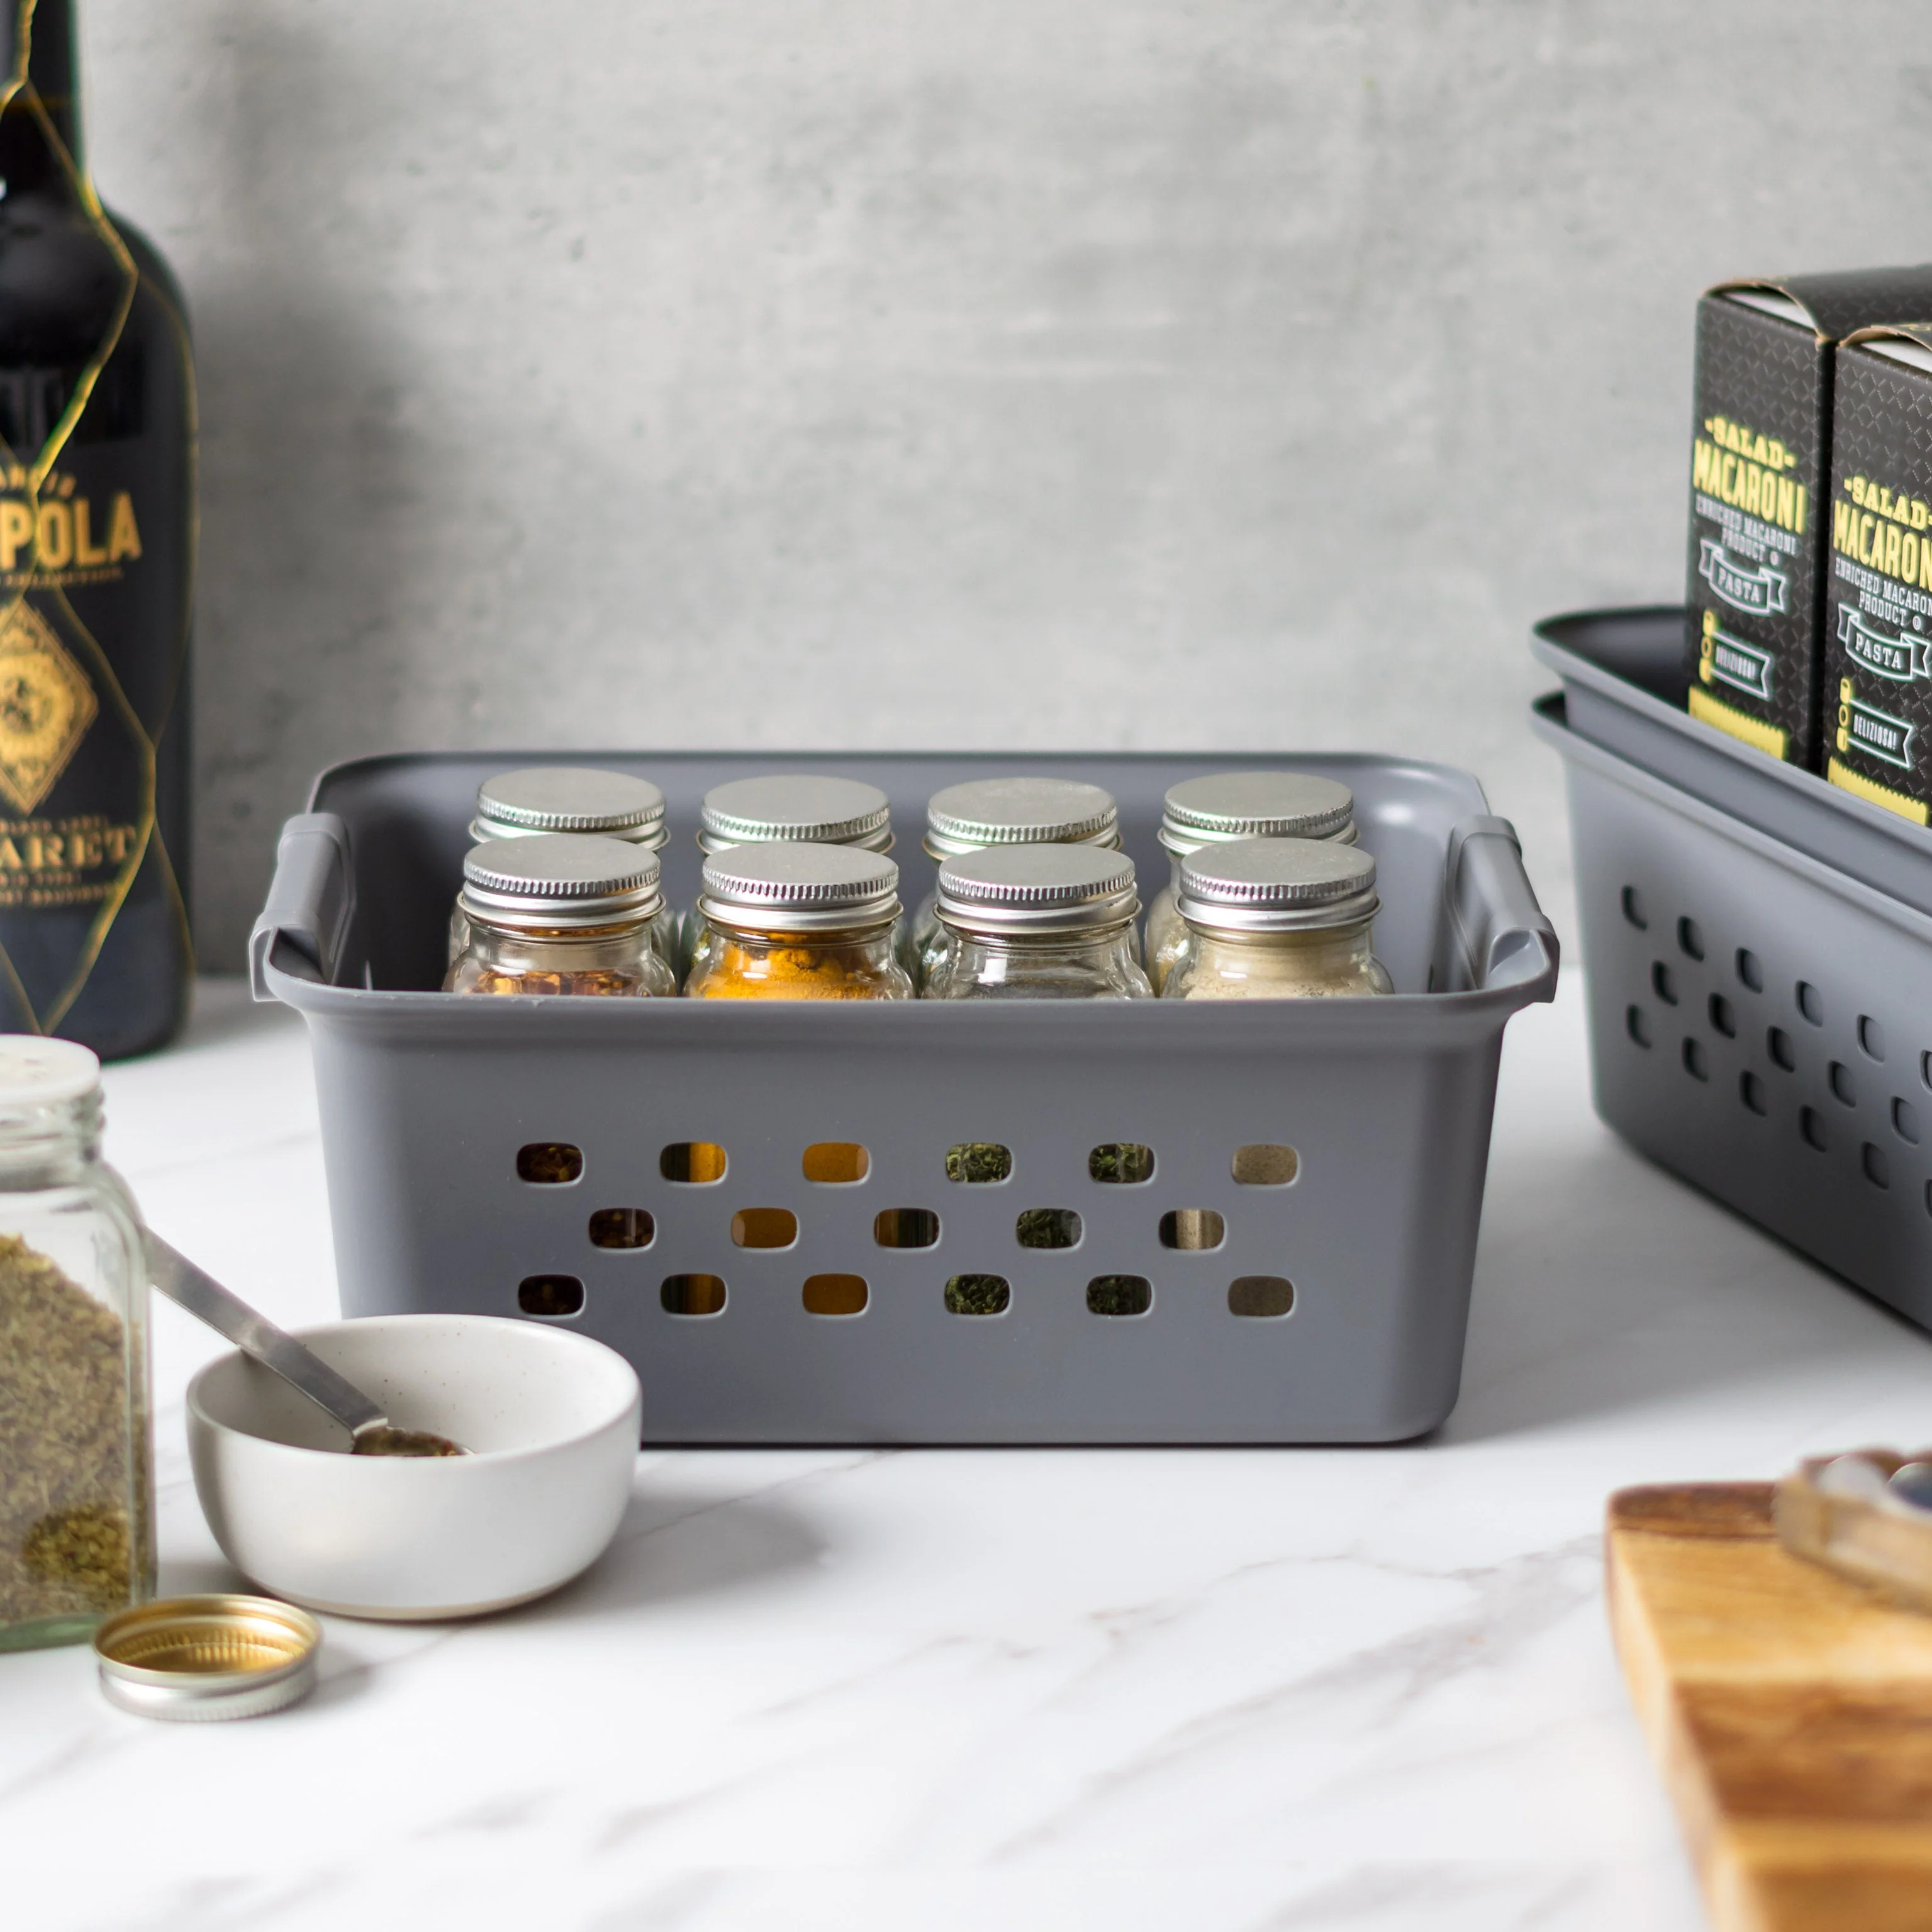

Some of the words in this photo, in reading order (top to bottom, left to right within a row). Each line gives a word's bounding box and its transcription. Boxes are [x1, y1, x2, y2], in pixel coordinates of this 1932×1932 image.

[1694, 438, 1806, 535] MACARONI
[1718, 567, 1761, 603] PASTA
[1835, 557, 1880, 595] ENRICHED
[1858, 590, 1907, 627] PRODUCT
[1855, 633, 1902, 669] PASTA
[1853, 713, 1897, 751] DELIZIOSA!
